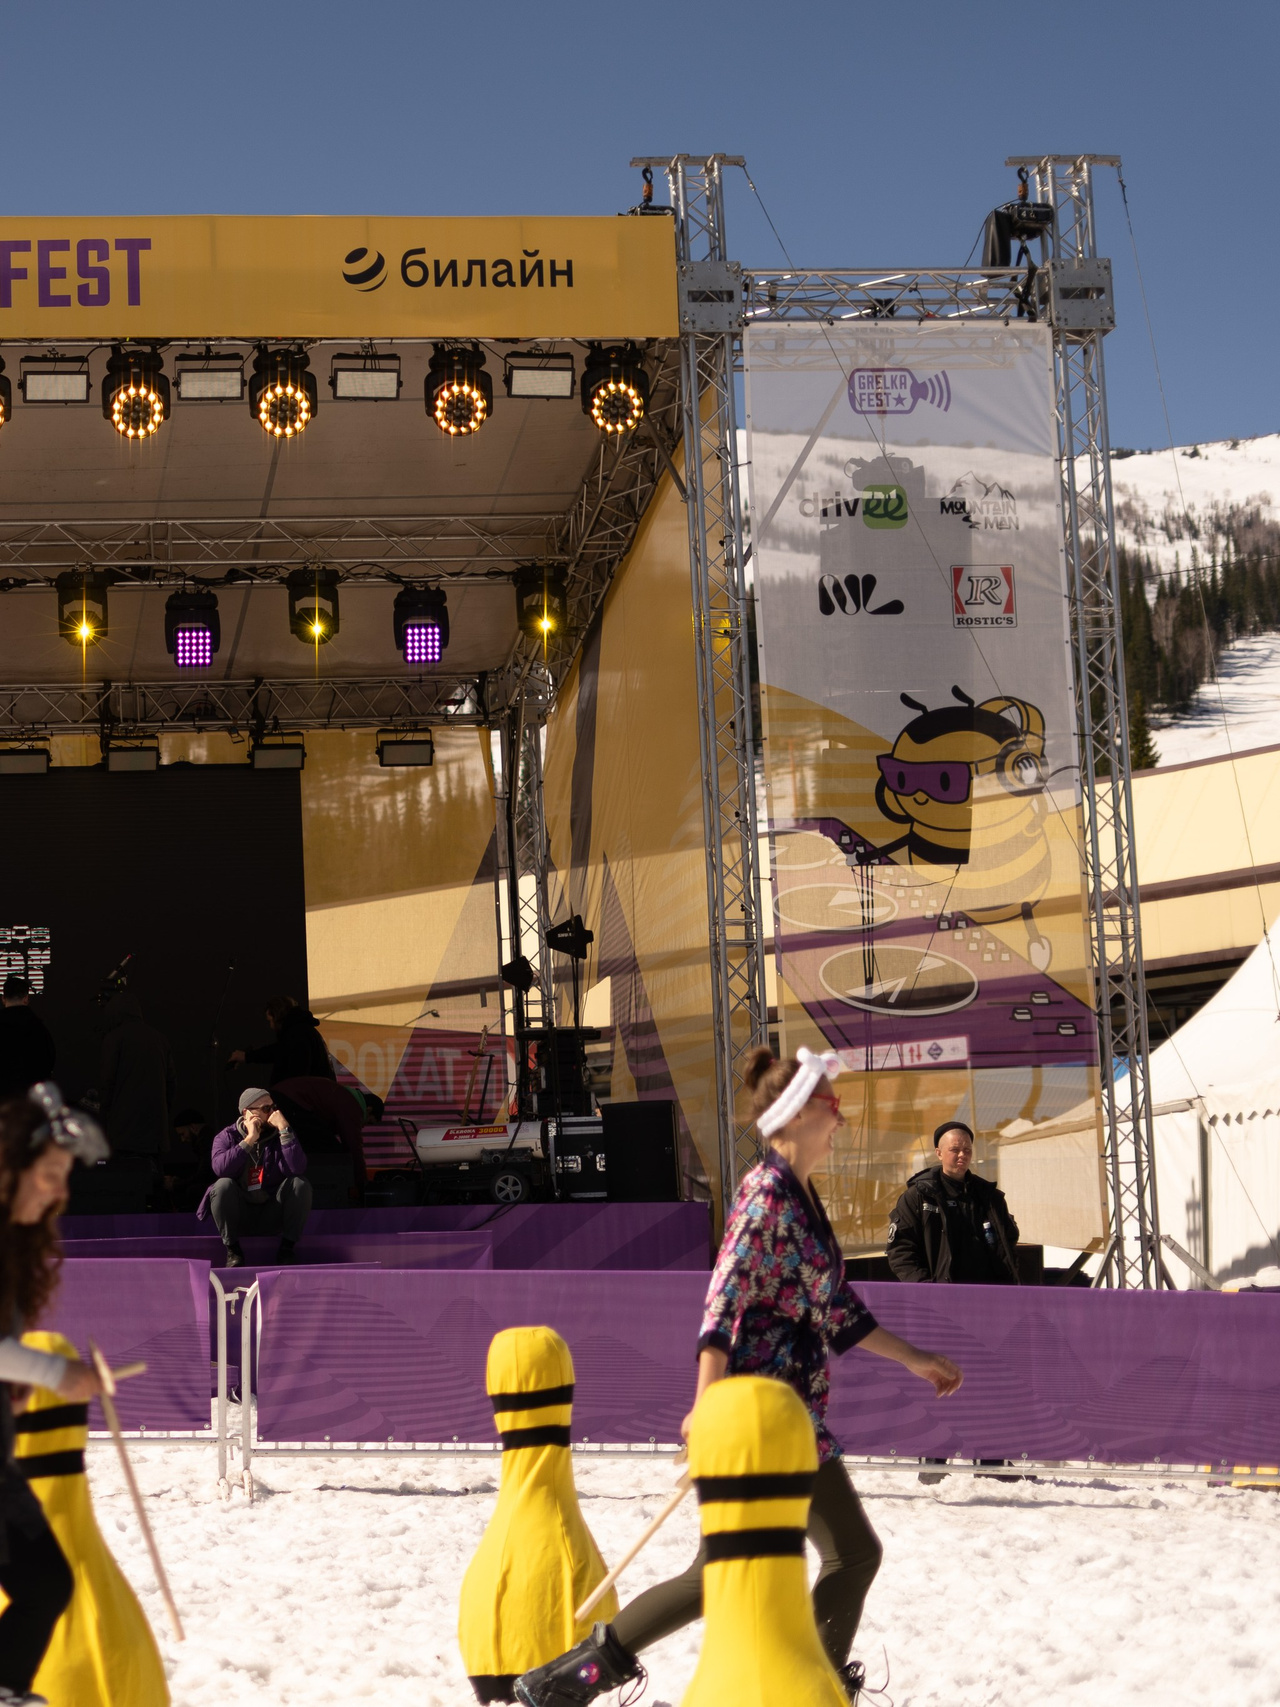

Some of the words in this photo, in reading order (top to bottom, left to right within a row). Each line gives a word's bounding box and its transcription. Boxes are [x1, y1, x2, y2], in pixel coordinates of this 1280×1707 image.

[400, 247, 574, 288] билайн
[858, 375, 907, 390] GRELKA
[858, 393, 891, 407] FEST
[799, 491, 908, 521] drivee
[940, 501, 1017, 515] MOUNTAIN
[984, 516, 1019, 530] MAN
[965, 576, 1002, 605] R
[956, 617, 1014, 626] ROSTIC'S
